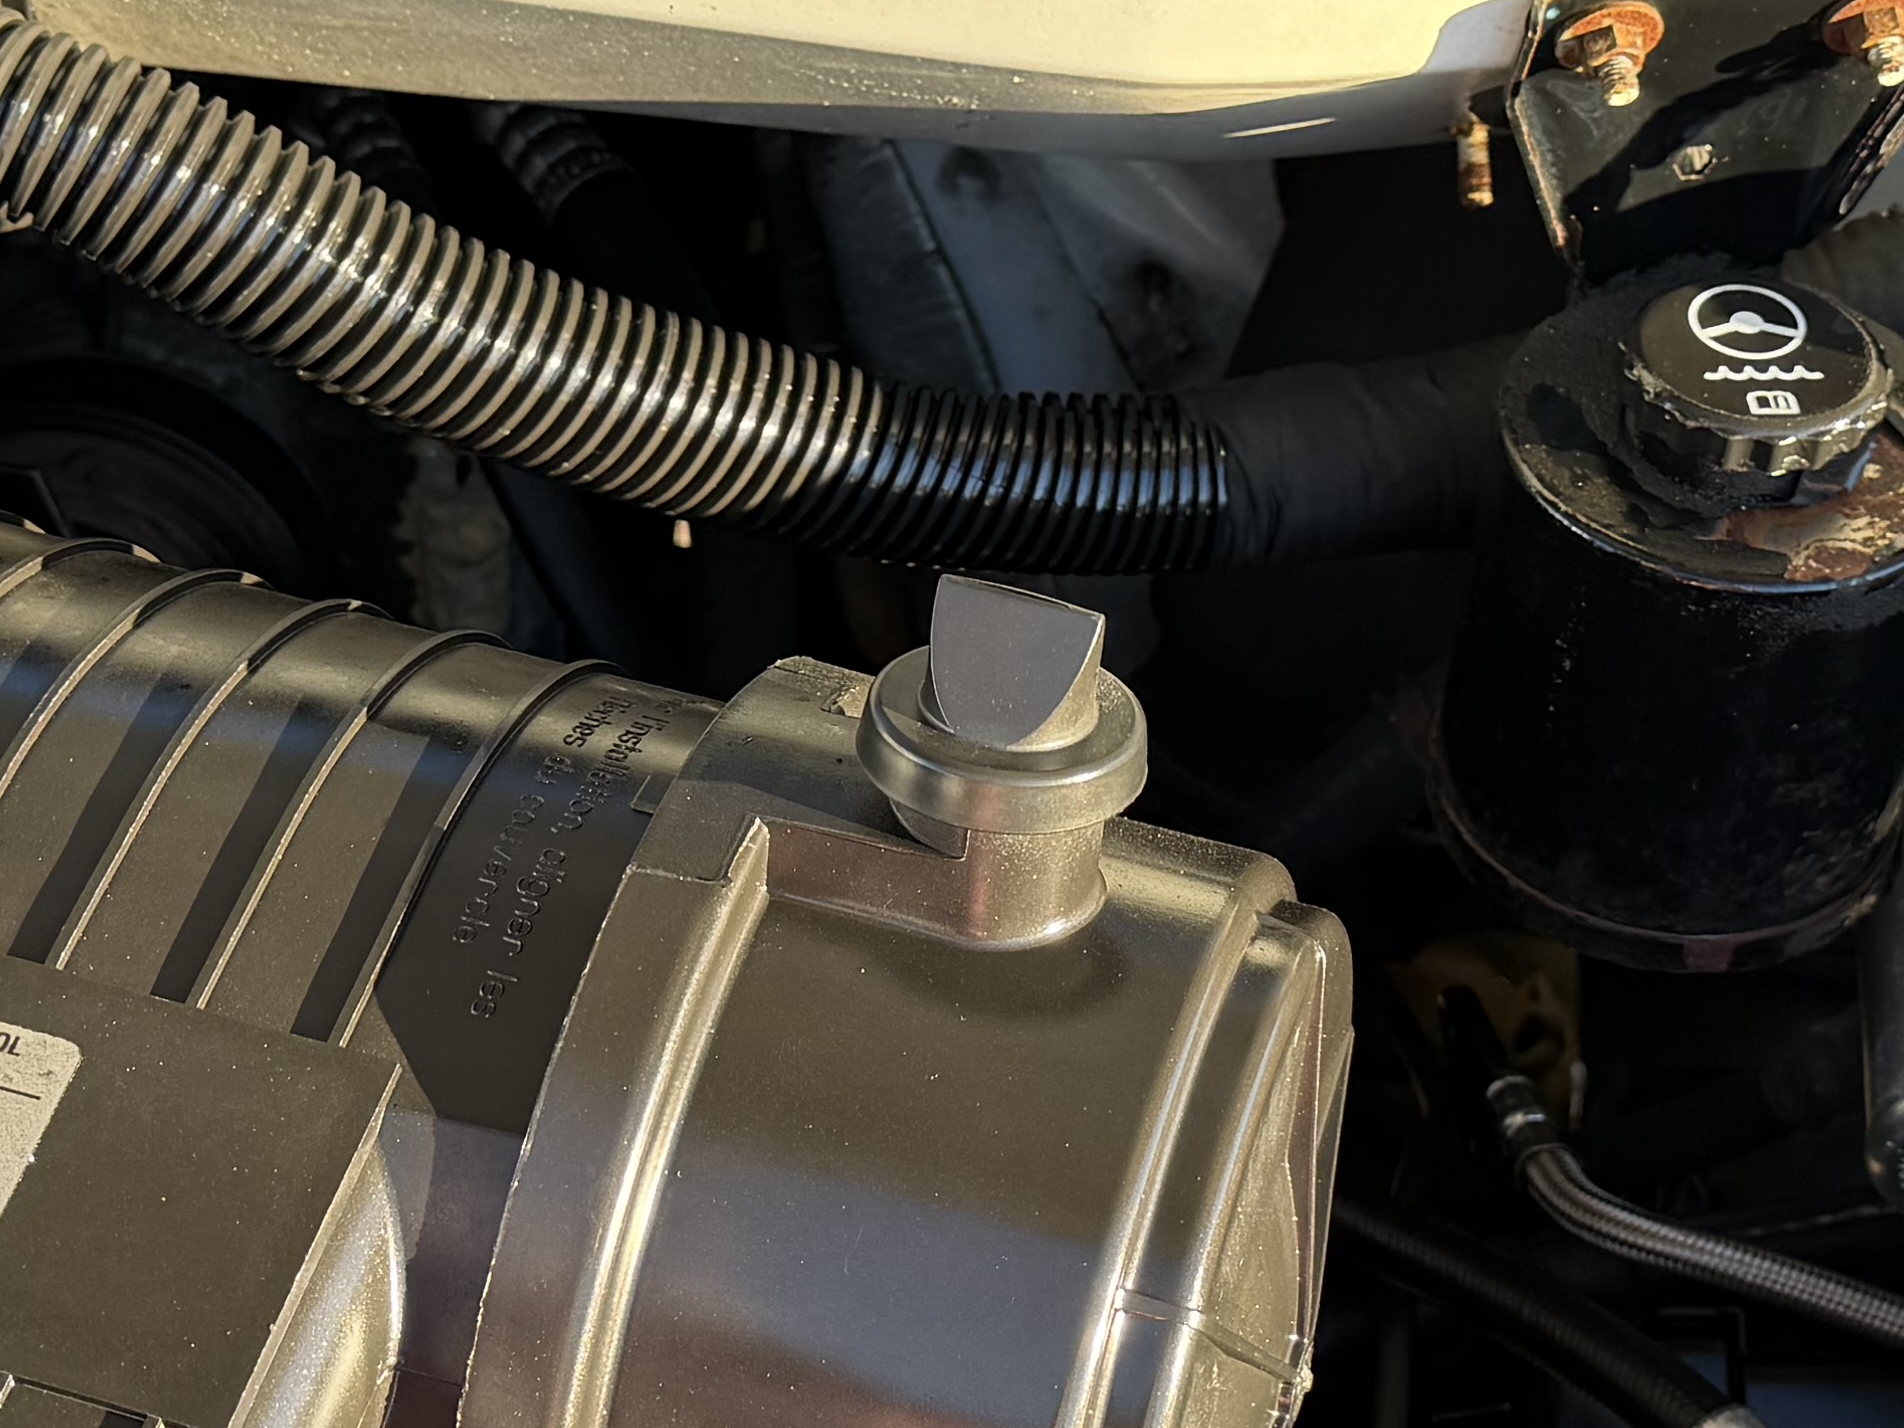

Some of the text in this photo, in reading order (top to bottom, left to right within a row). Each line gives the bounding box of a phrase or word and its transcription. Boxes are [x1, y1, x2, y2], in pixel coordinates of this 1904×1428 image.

[452, 794, 545, 943] couvercle
[502, 847, 567, 956] aligner
[470, 970, 518, 1018] les
